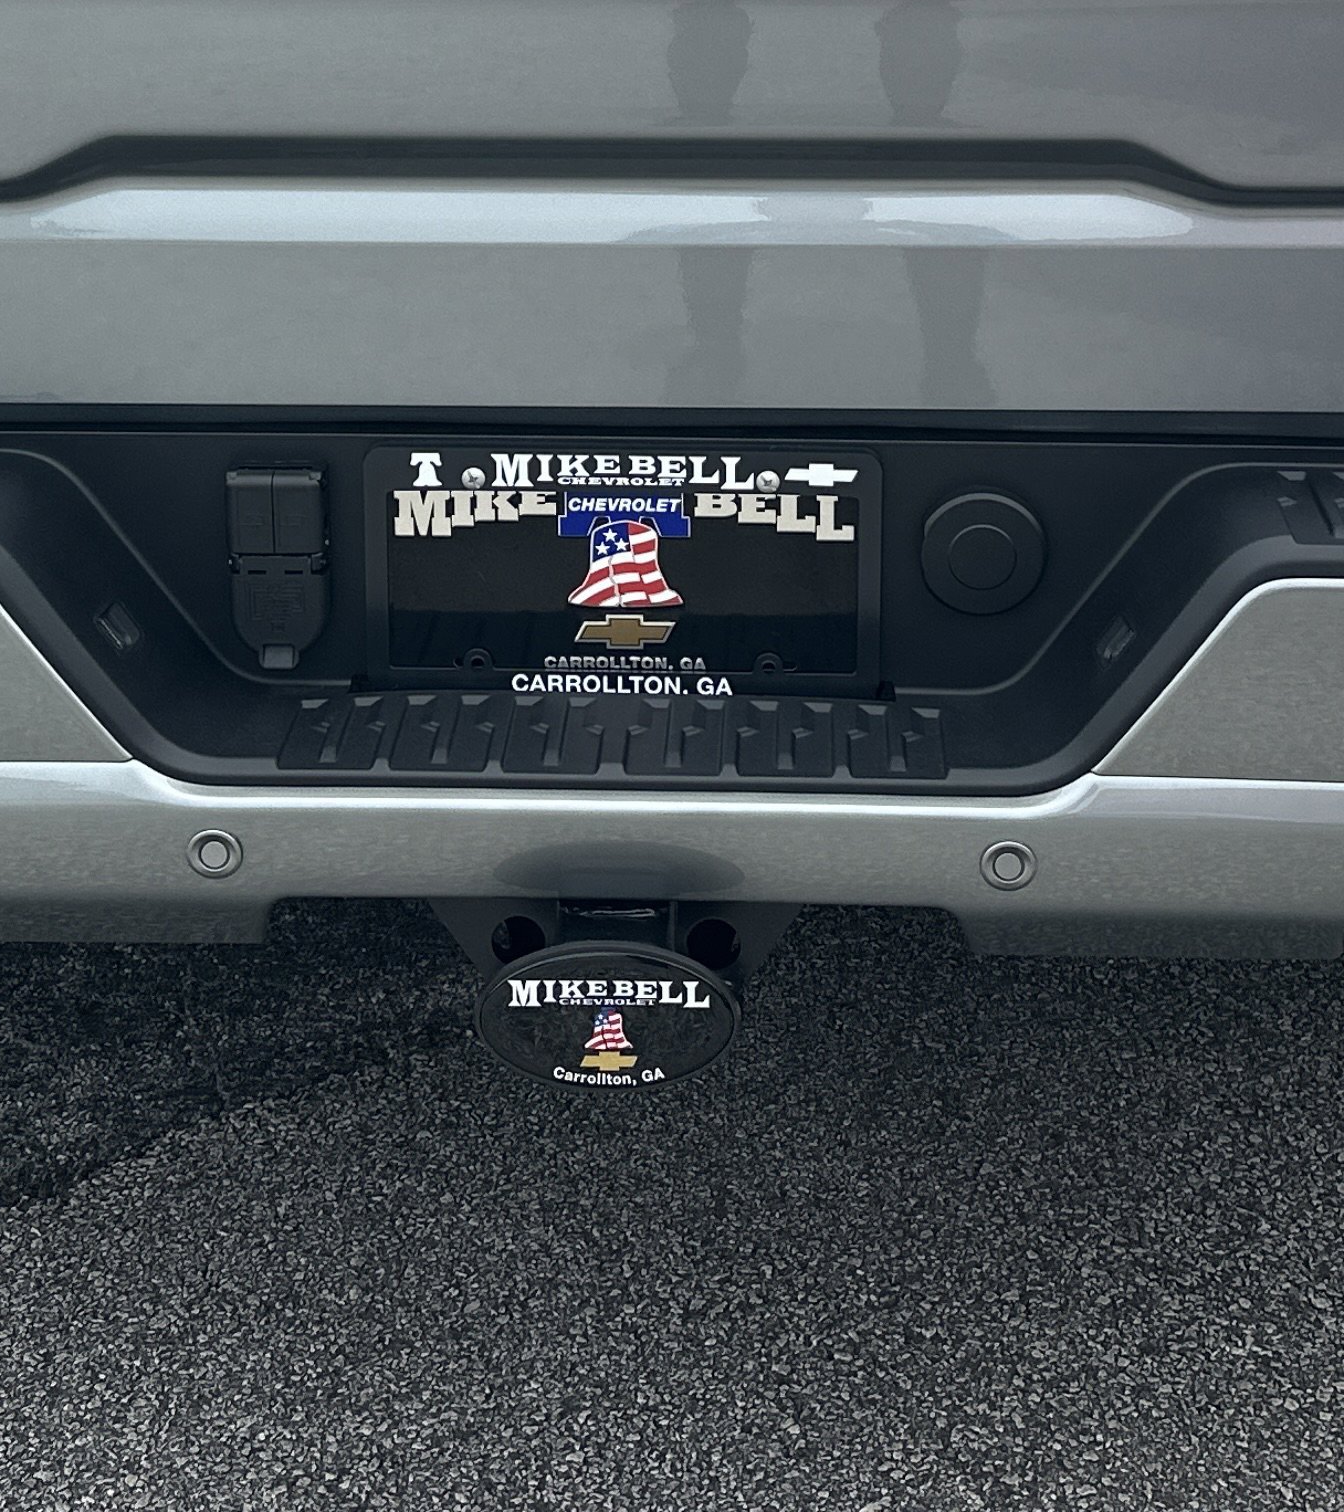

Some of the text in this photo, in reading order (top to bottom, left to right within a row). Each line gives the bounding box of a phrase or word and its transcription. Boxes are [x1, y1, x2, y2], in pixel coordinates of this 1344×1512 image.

[490, 452, 756, 490] MIKE BELL
[557, 476, 685, 486] CHEVROLET
[568, 497, 682, 513] CHEVROLET
[393, 489, 855, 542] MIKE BELL
[679, 656, 706, 671] GA
[696, 676, 733, 696] GA
[507, 979, 711, 1009] MIKE BELL
[558, 998, 656, 1006] CHEVROLET
[553, 1066, 666, 1086] Carrollton, GA
